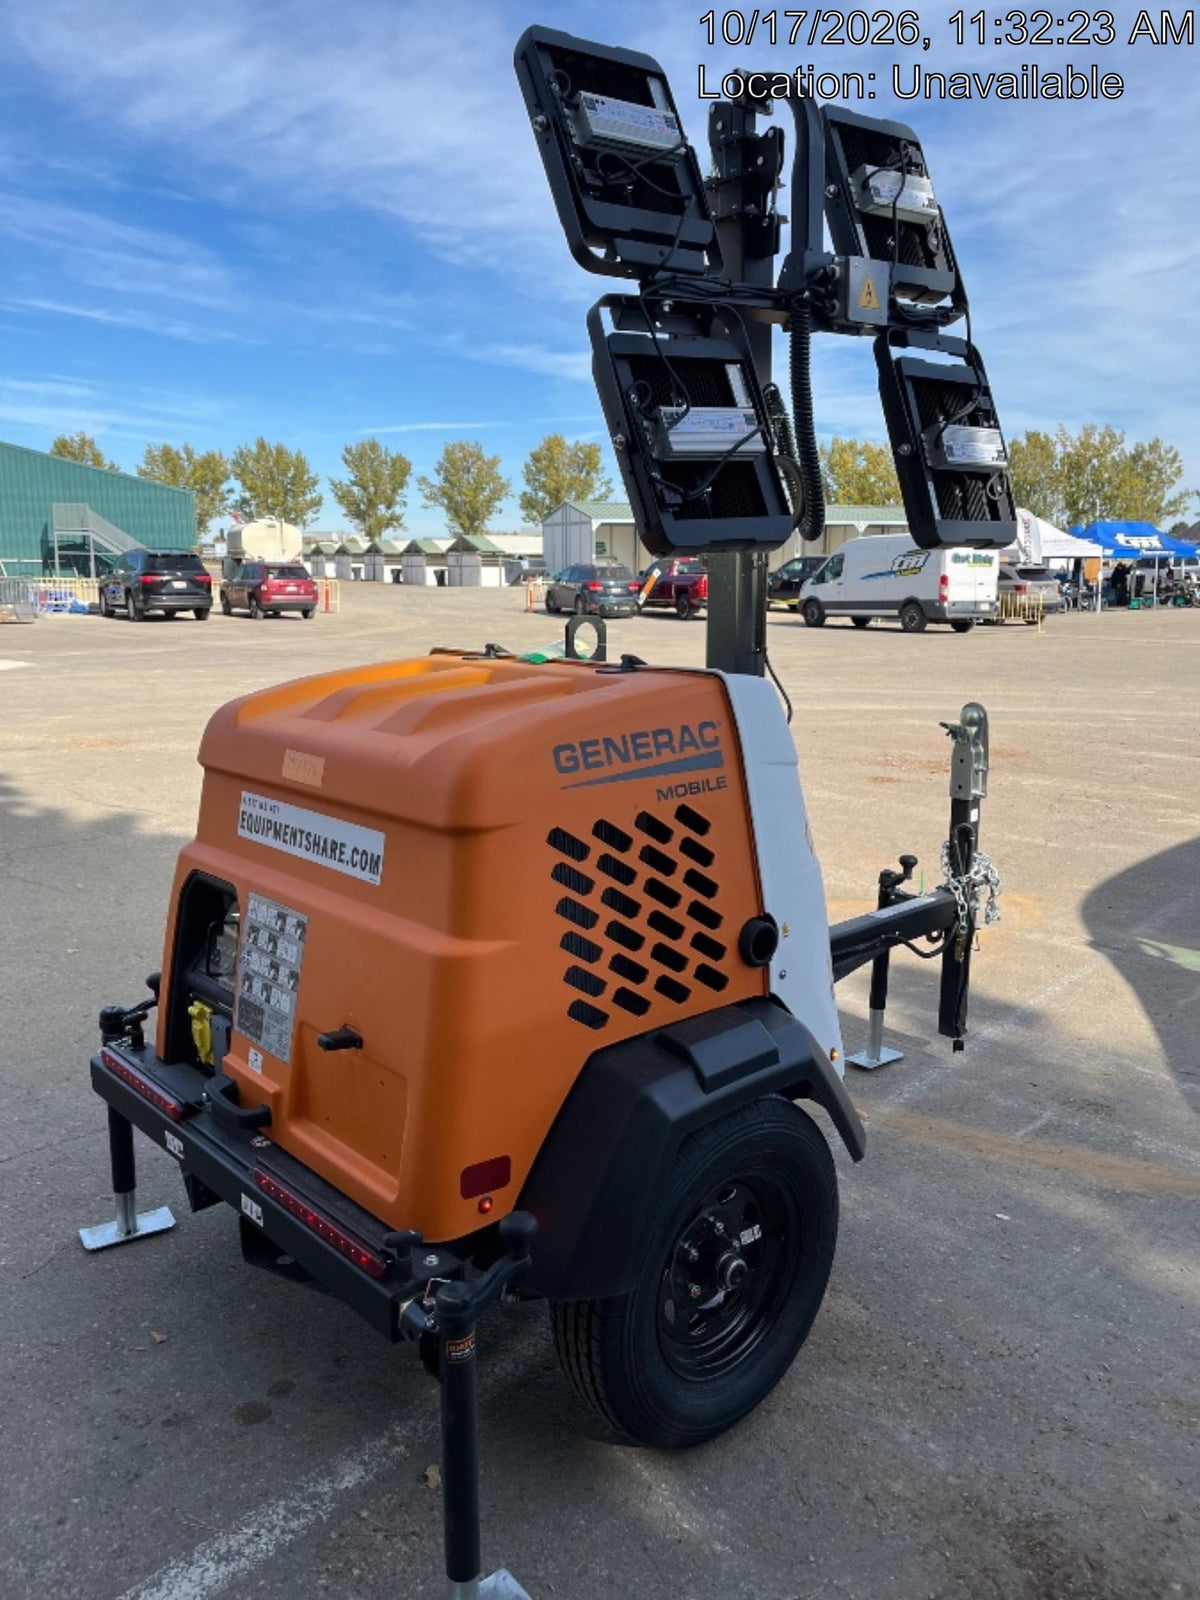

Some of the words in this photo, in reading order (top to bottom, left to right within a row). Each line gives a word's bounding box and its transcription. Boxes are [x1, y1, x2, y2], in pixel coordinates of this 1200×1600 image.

[552, 721, 720, 774] GENERAC
[656, 776, 728, 802] MOBILE
[239, 810, 382, 876] EQUIPMENTSHARE.COM
